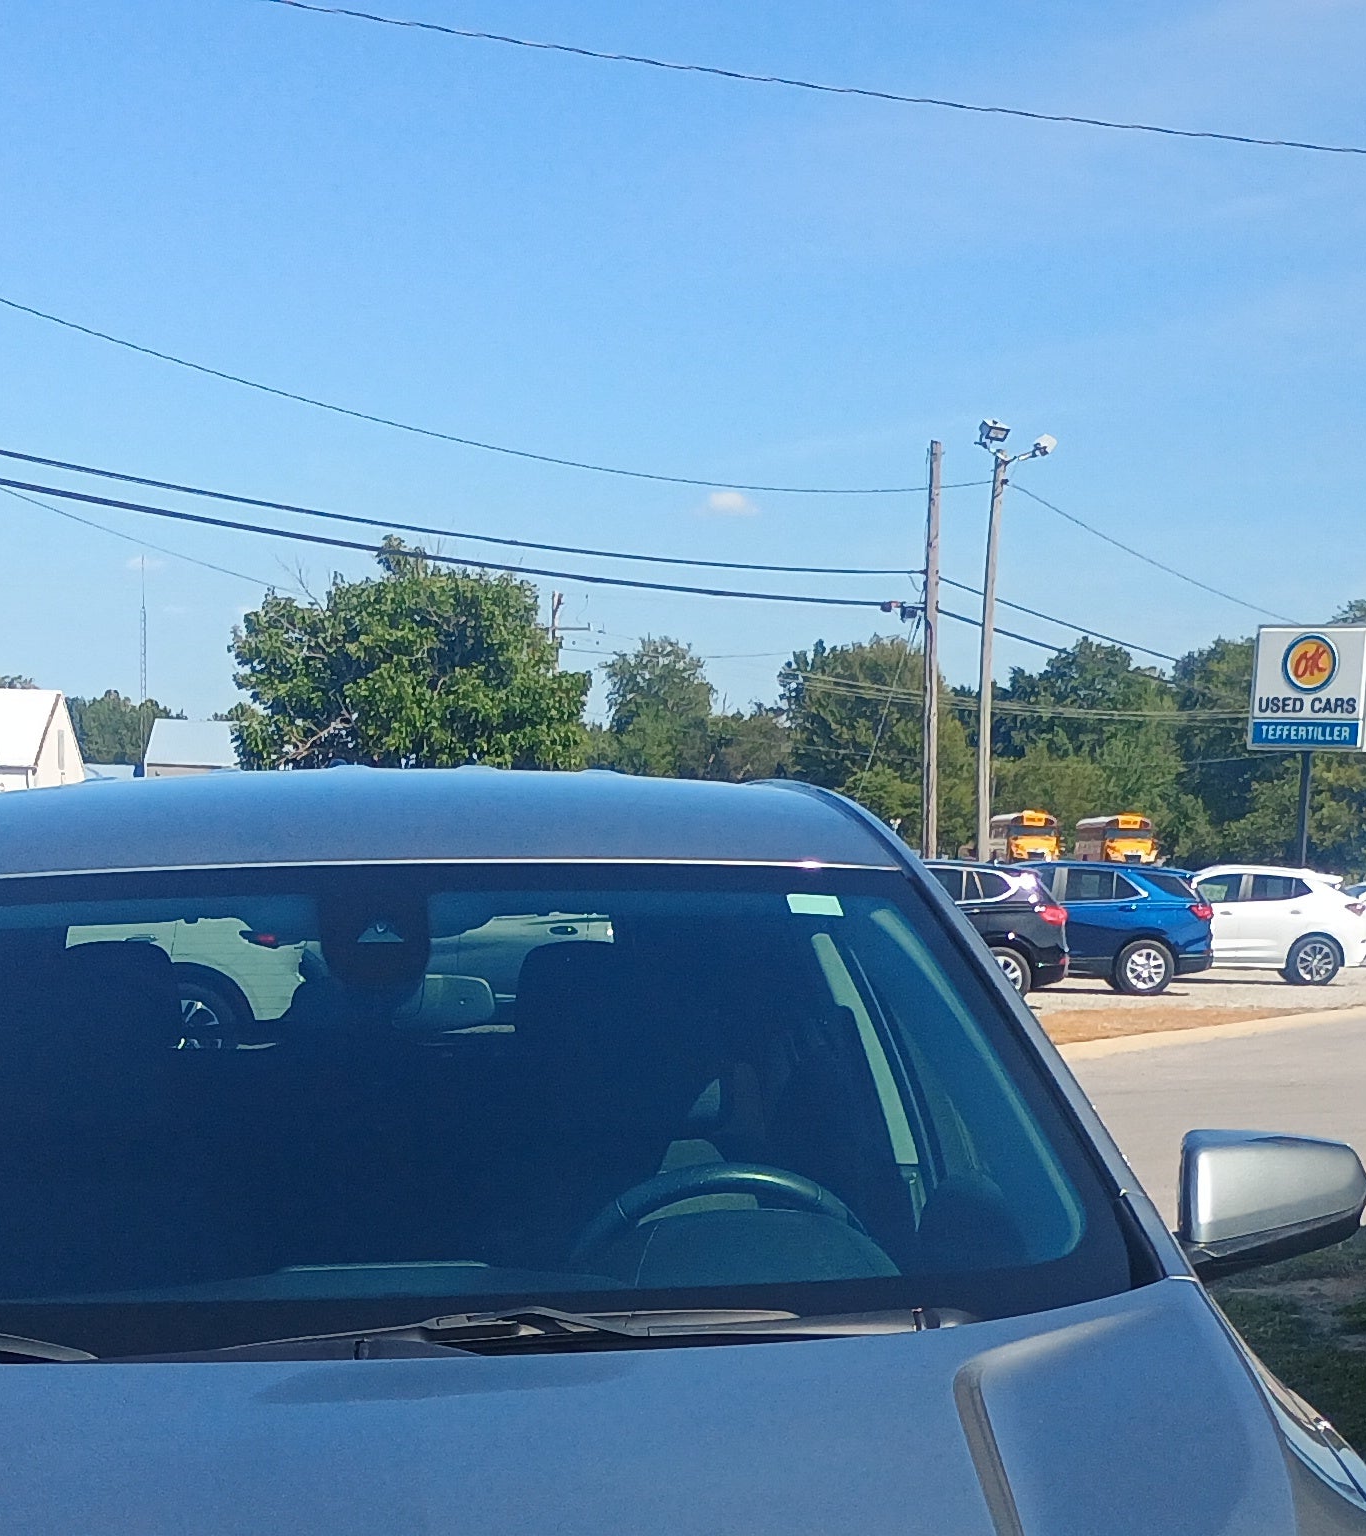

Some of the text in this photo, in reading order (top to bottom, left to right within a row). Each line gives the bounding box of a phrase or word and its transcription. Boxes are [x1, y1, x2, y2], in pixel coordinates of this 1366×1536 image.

[1292, 644, 1327, 679] OK
[1258, 696, 1357, 714] USED CARS
[1261, 724, 1350, 741] TEFFERTILLER
